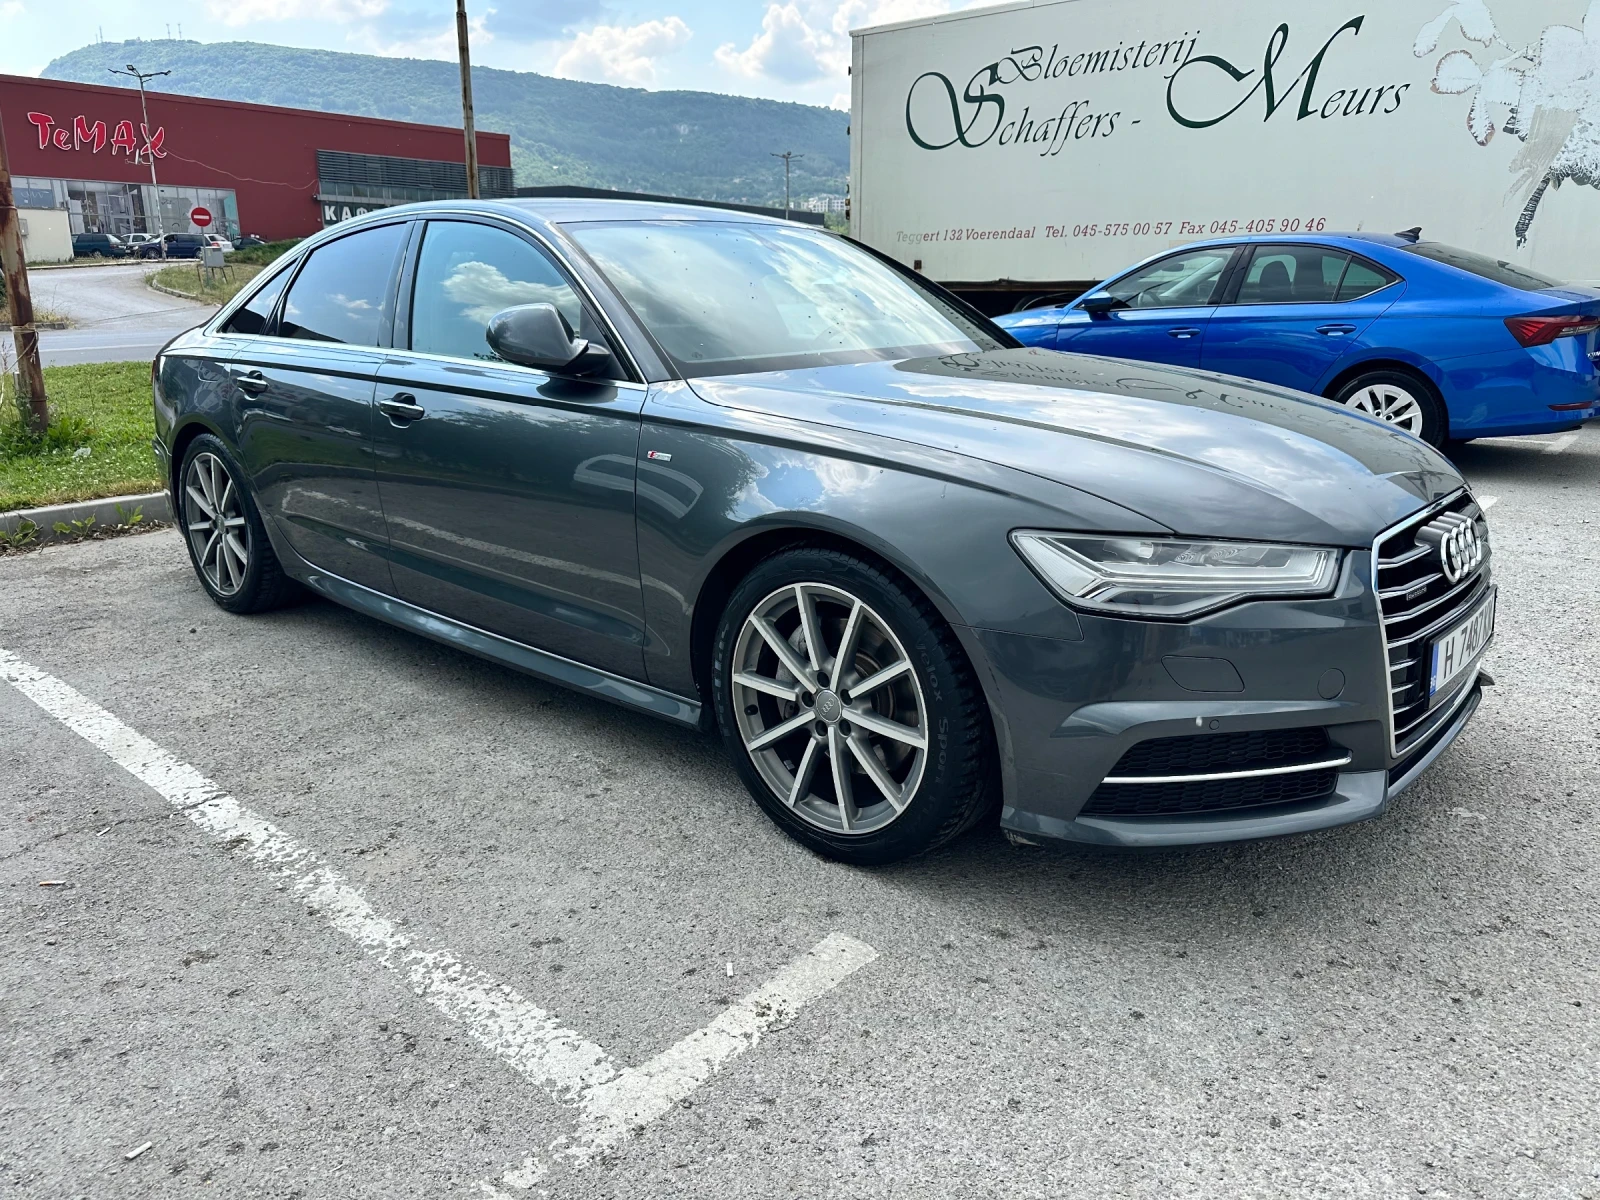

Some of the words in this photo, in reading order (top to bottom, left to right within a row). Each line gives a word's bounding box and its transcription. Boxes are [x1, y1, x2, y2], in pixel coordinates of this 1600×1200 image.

[996, 30, 1201, 85] Bloemisterij
[905, 62, 1122, 157] Schaffers
[1166, 15, 1411, 129] Meurs
[896, 229, 940, 246] Teggert
[943, 228, 963, 241] 132
[965, 226, 1036, 241] Voerendaal
[1044, 225, 1068, 239] Tel.
[1072, 223, 1129, 237] 045-575
[1132, 222, 1150, 236] 00
[1153, 221, 1173, 235] 57
[1178, 221, 1205, 235] Fax
[1209, 219, 1276, 234] 045-405
[1279, 218, 1300, 232] 90
[1304, 217, 1326, 232] 46
[1443, 636, 1455, 680] H
